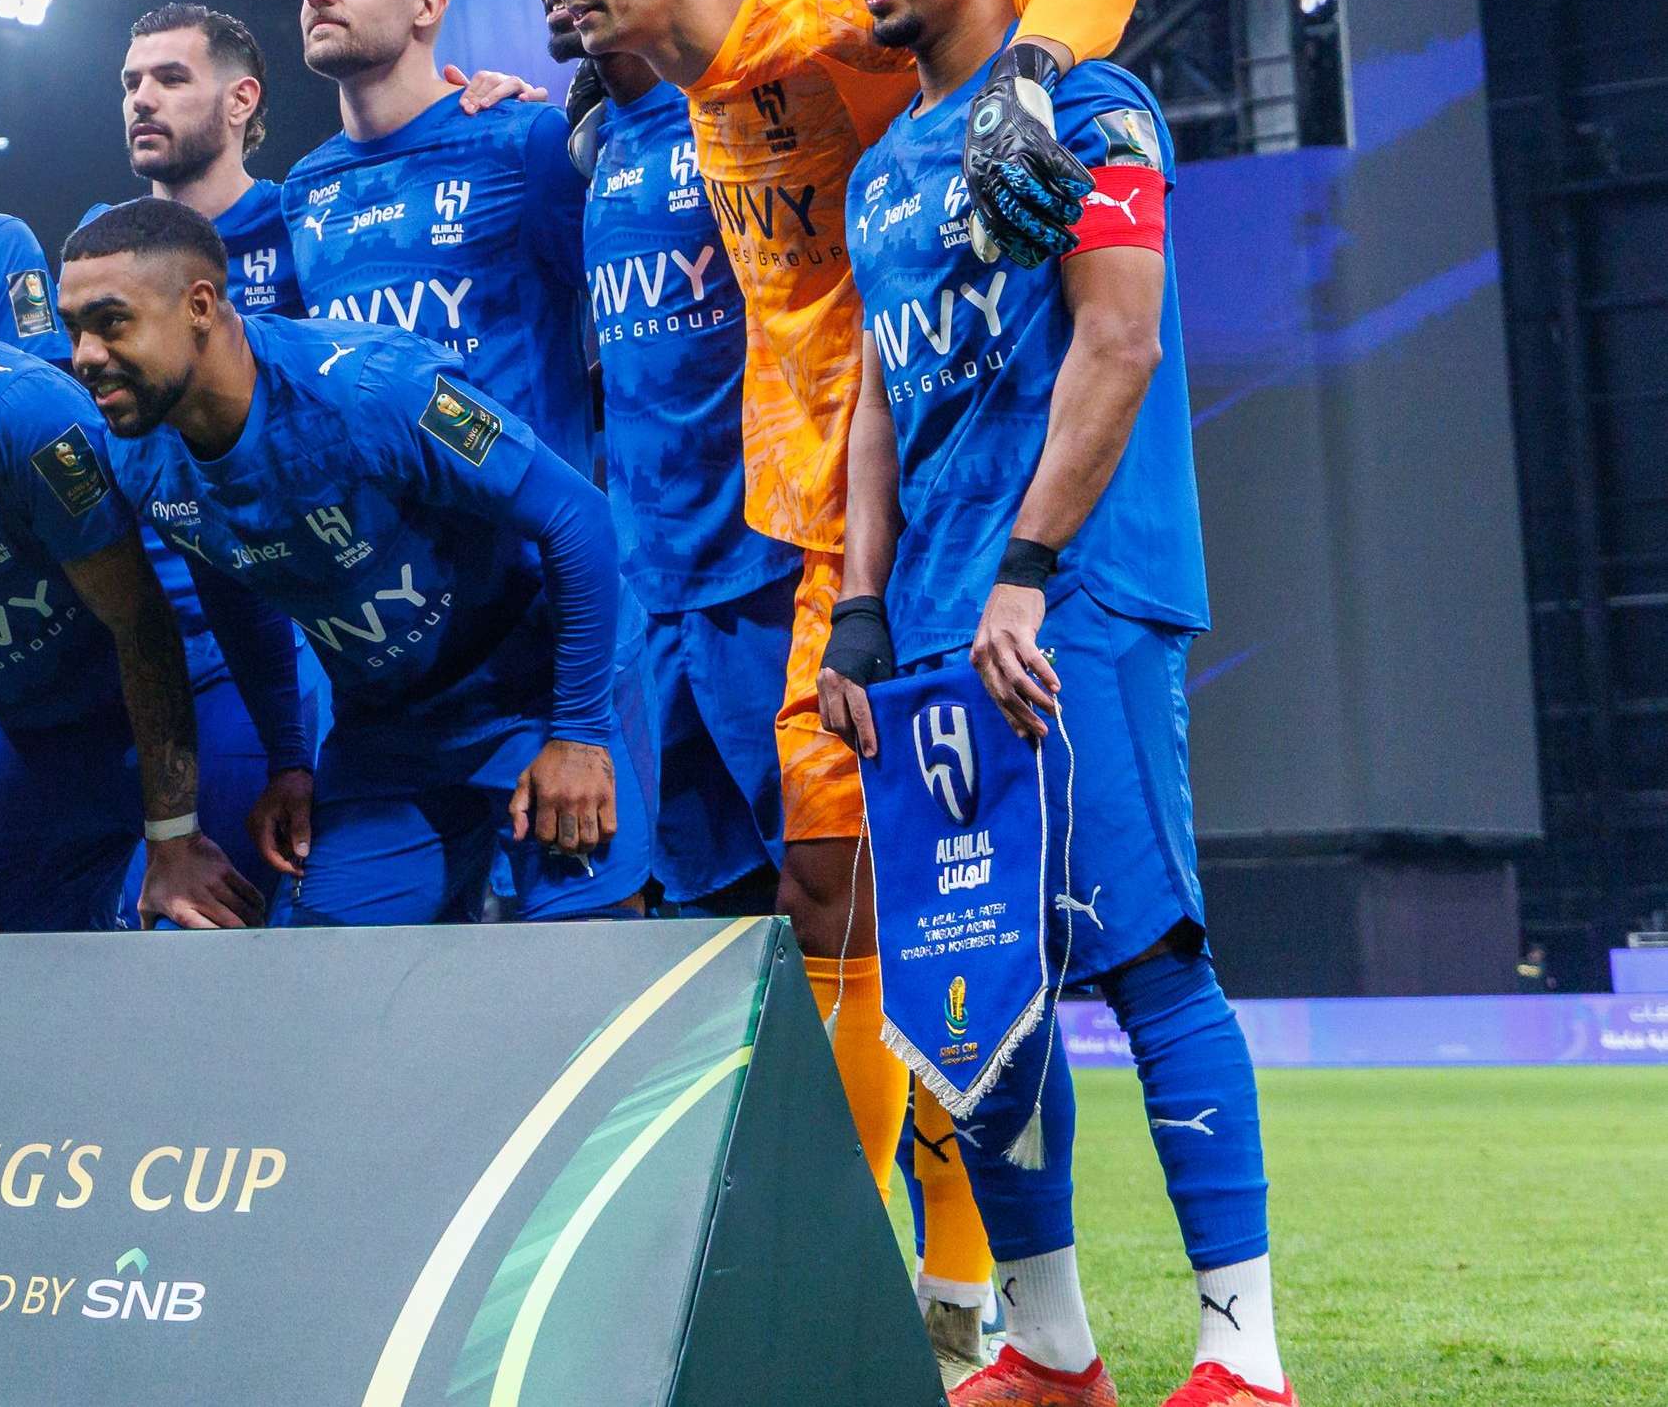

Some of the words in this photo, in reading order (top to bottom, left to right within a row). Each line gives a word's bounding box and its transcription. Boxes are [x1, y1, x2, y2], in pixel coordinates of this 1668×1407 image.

[347, 203, 406, 234] Jahez
[879, 193, 922, 233] Jahez
[431, 224, 465, 235] ALHILAL
[244, 286, 276, 297] ALHILAL
[586, 245, 715, 324] AVVY
[633, 308, 725, 338] GROUP
[152, 500, 200, 521] flynas
[232, 541, 293, 569] Jahez
[367, 593, 453, 667] GROUP
[936, 830, 995, 865] ALHILAL
[938, 858, 992, 896] الهلال
[917, 916, 930, 928] AL
[964, 908, 975, 920] AL
[925, 924, 965, 942] KINGDOM
[966, 918, 997, 934] ARENA
[948, 934, 996, 953] NOVEMBER
[999, 929, 1021, 945] 2025
[128, 1144, 288, 1215] CUP
[21, 1275, 75, 1317] BY
[80, 1278, 206, 1323] SNB
